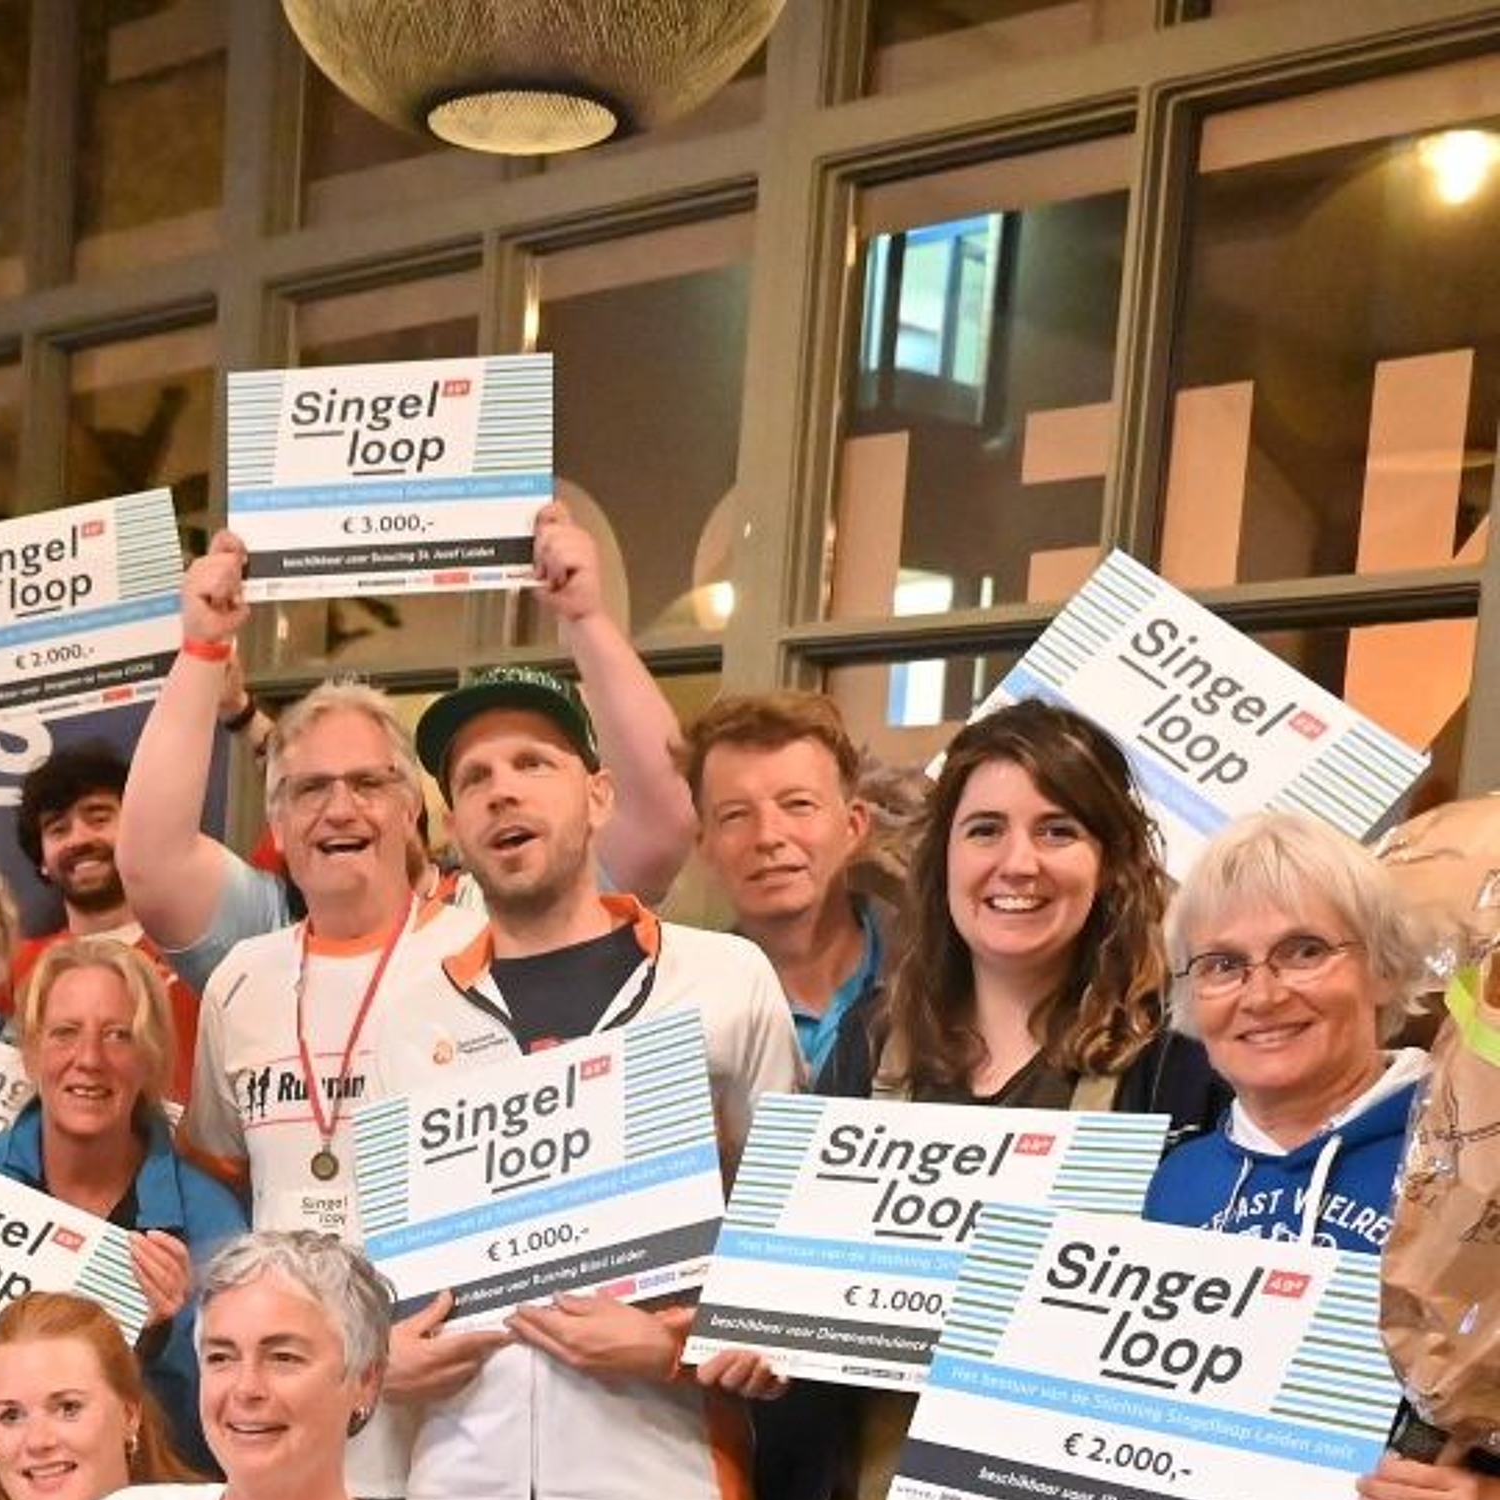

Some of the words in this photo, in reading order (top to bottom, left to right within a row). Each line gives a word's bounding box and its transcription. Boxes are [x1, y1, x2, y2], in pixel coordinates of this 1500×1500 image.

[291, 381, 439, 431] Singel
[347, 430, 445, 472] loop
[343, 517, 354, 534] €
[361, 512, 433, 536] 3.000,-
[10, 573, 92, 610] loop
[1131, 618, 1297, 737] Singel
[1144, 694, 1249, 784] loop
[420, 1064, 575, 1151] Singel
[485, 1126, 591, 1184] loop
[820, 1125, 1014, 1185] Singel
[486, 1241, 501, 1262] €
[507, 1218, 590, 1259] 1.000,-
[841, 1283, 862, 1304] €
[1046, 1242, 1264, 1320] Singel
[1100, 1311, 1243, 1394] loop
[977, 1466, 1062, 1496] beschikbaar
[1060, 1430, 1084, 1457] €
[1085, 1436, 1196, 1484] 2.000,-
